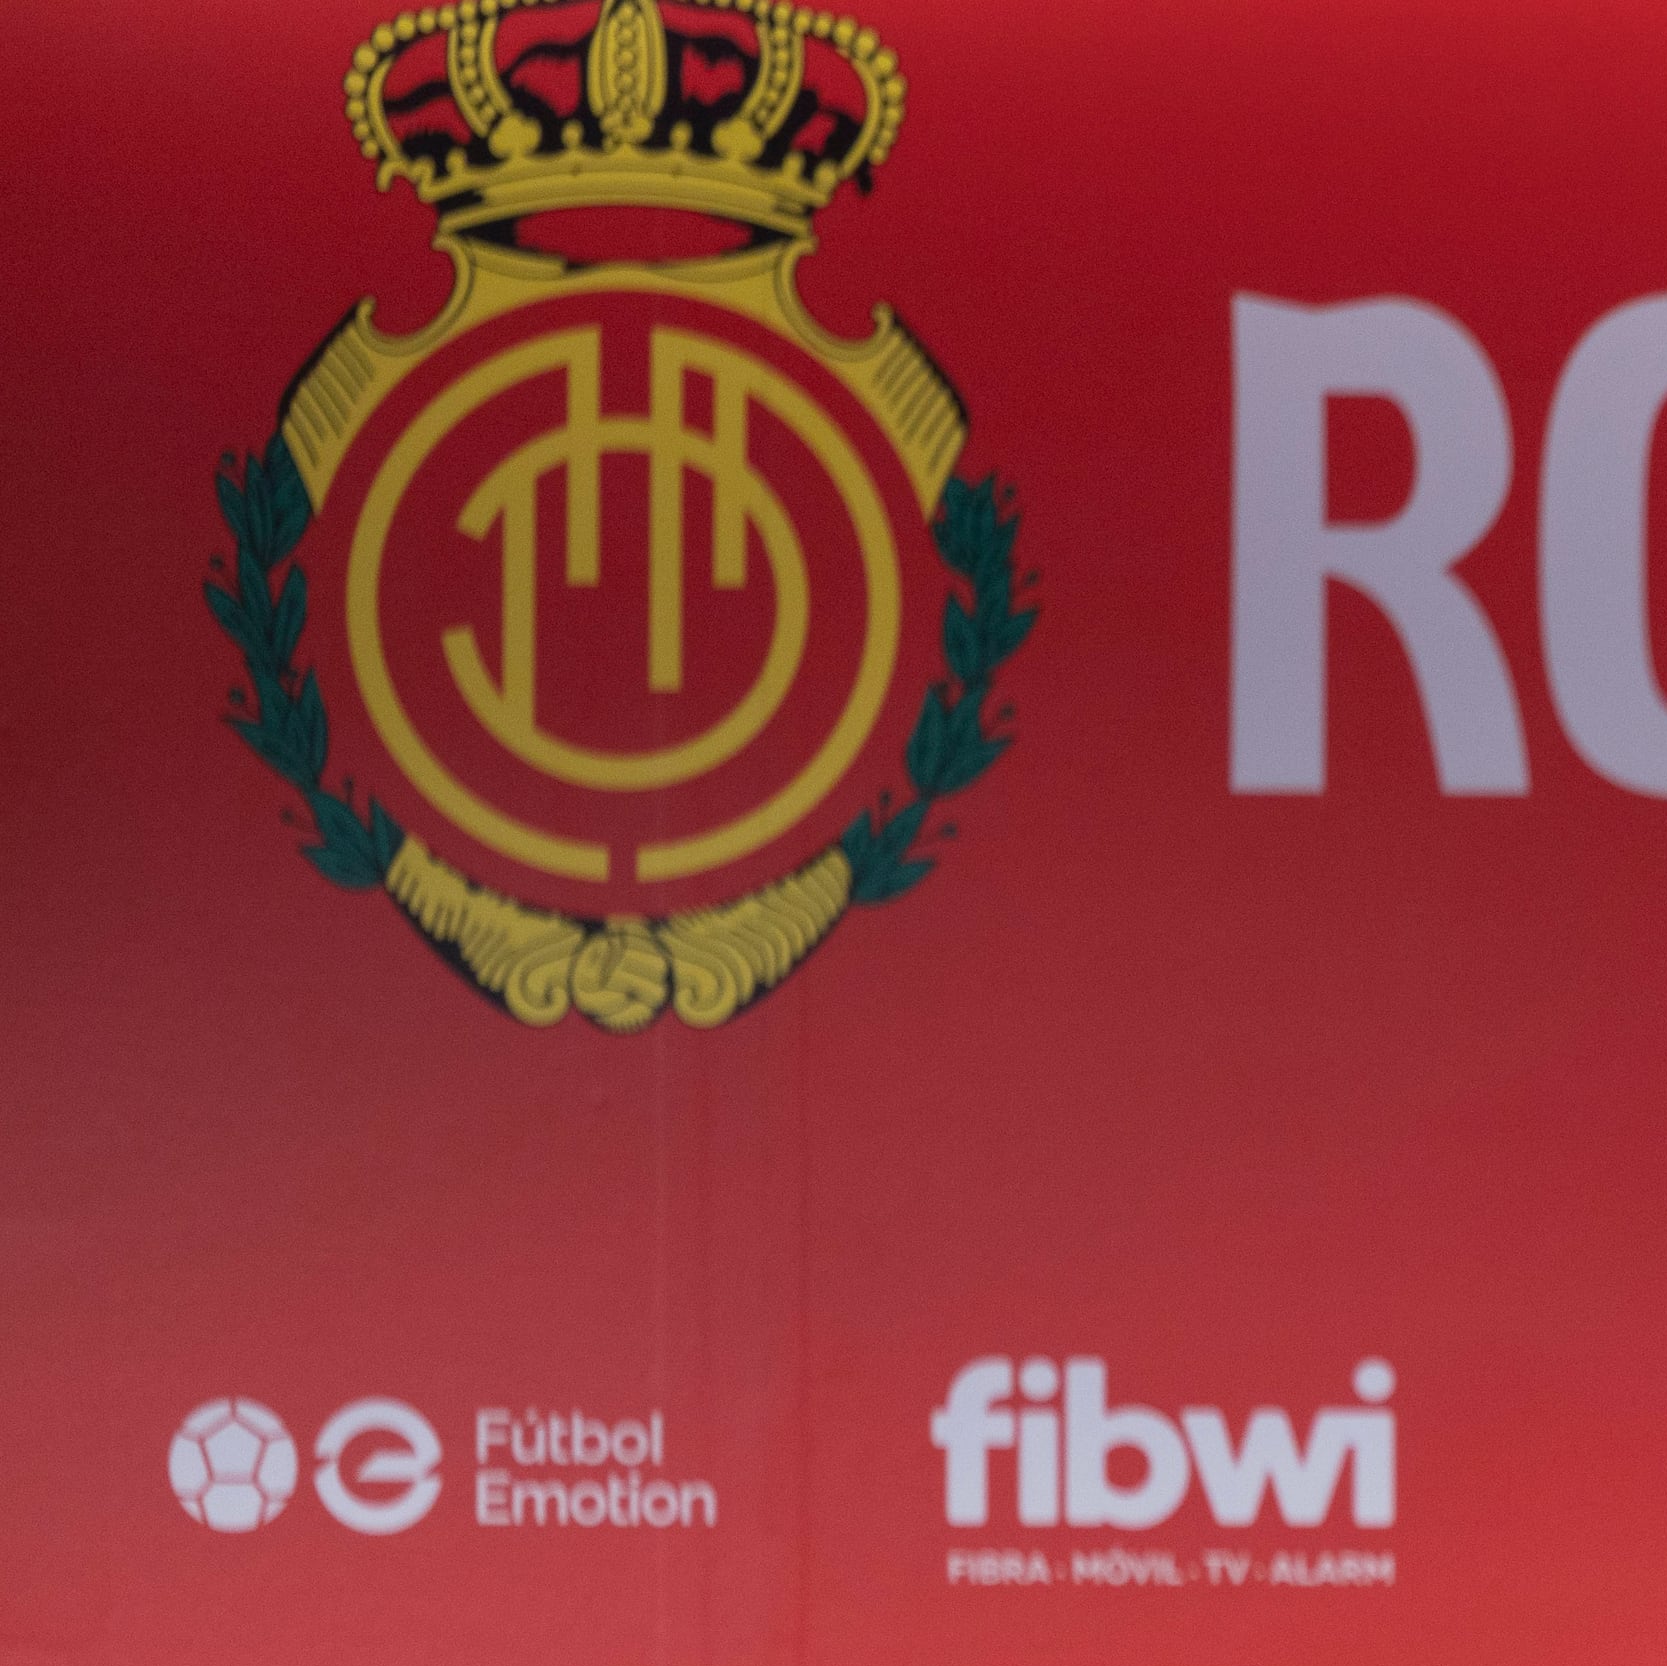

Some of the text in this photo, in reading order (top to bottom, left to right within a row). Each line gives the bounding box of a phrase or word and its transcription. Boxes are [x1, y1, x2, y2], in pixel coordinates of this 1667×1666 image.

[476, 1409, 663, 1467] Fútbol
[931, 1358, 1395, 1529] fibwi
[476, 1471, 716, 1527] Emotion
[948, 1549, 1394, 1585] FIBRA MÓVIL TV ALARM
